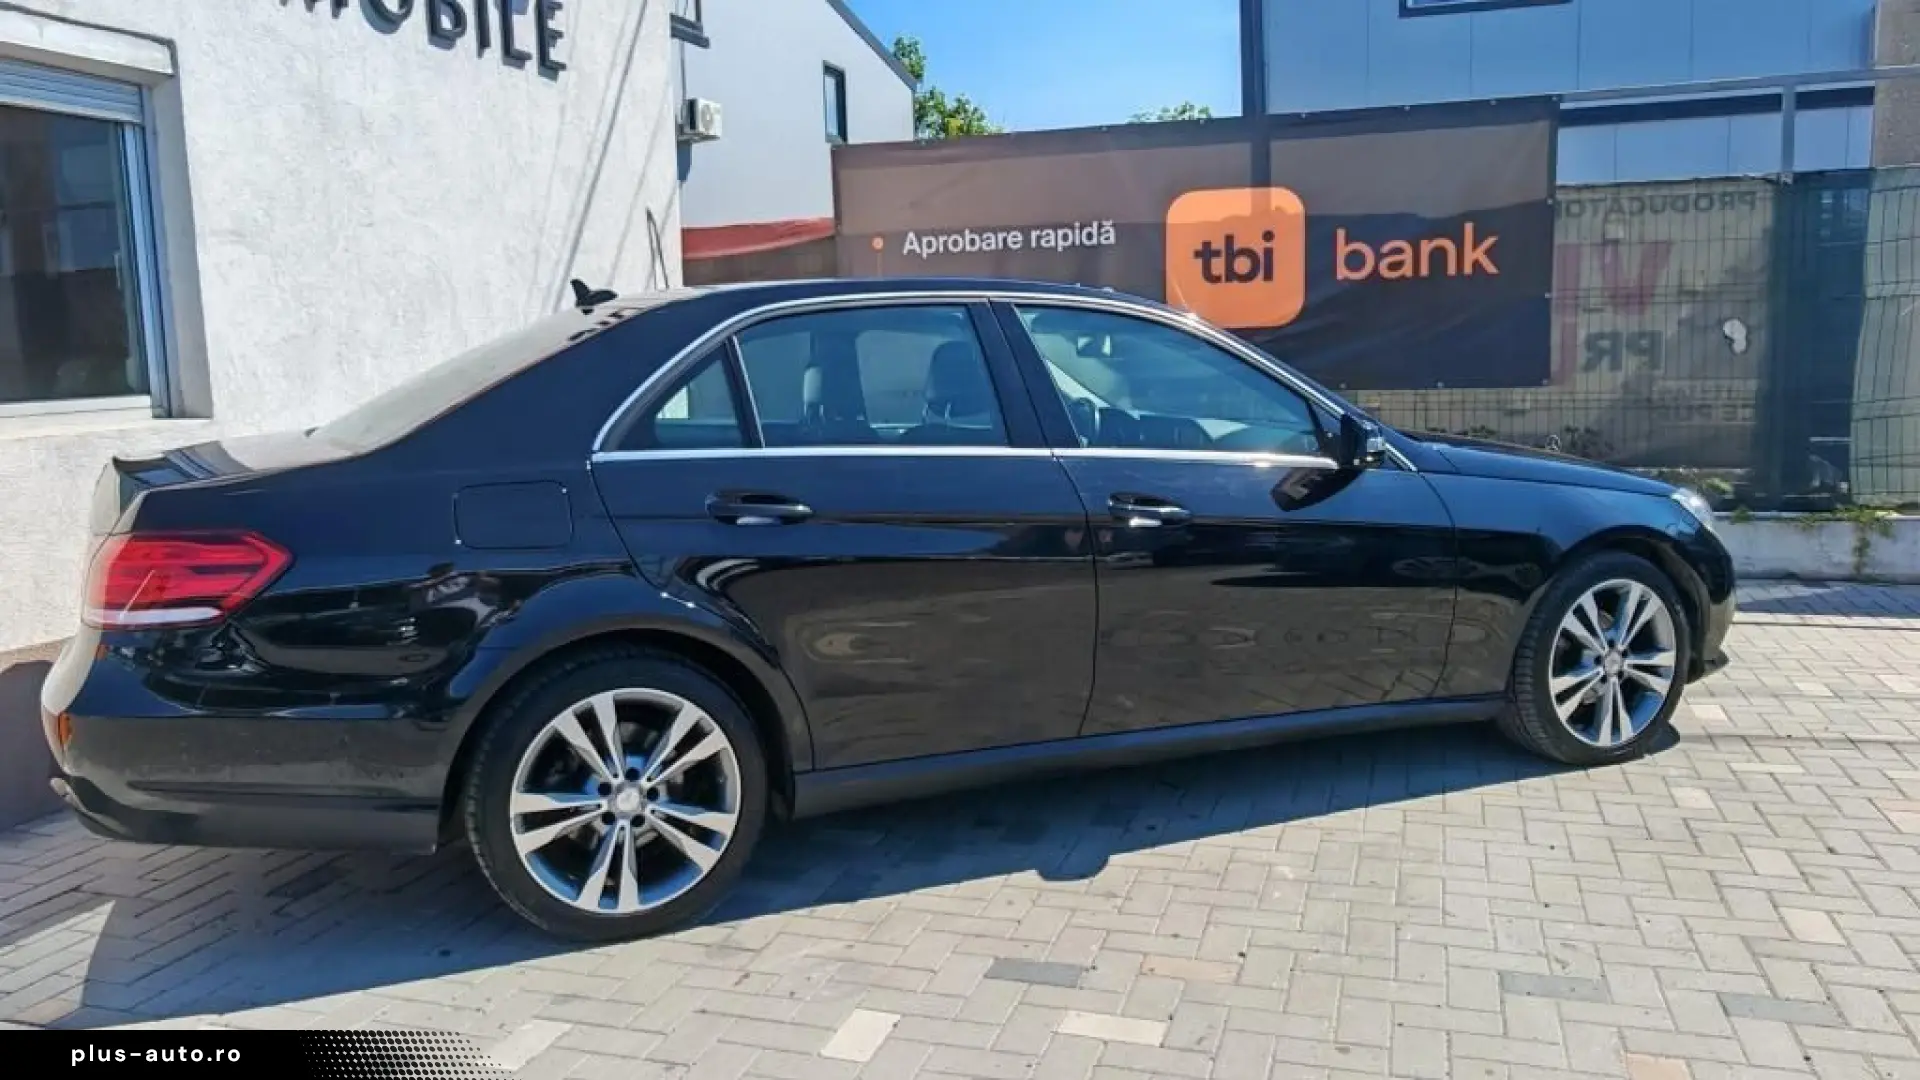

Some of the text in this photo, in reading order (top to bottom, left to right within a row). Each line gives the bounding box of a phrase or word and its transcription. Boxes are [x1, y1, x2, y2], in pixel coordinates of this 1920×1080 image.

[903, 219, 1116, 259] Aprobare rapidă
[1194, 221, 1499, 283] tbi bank
